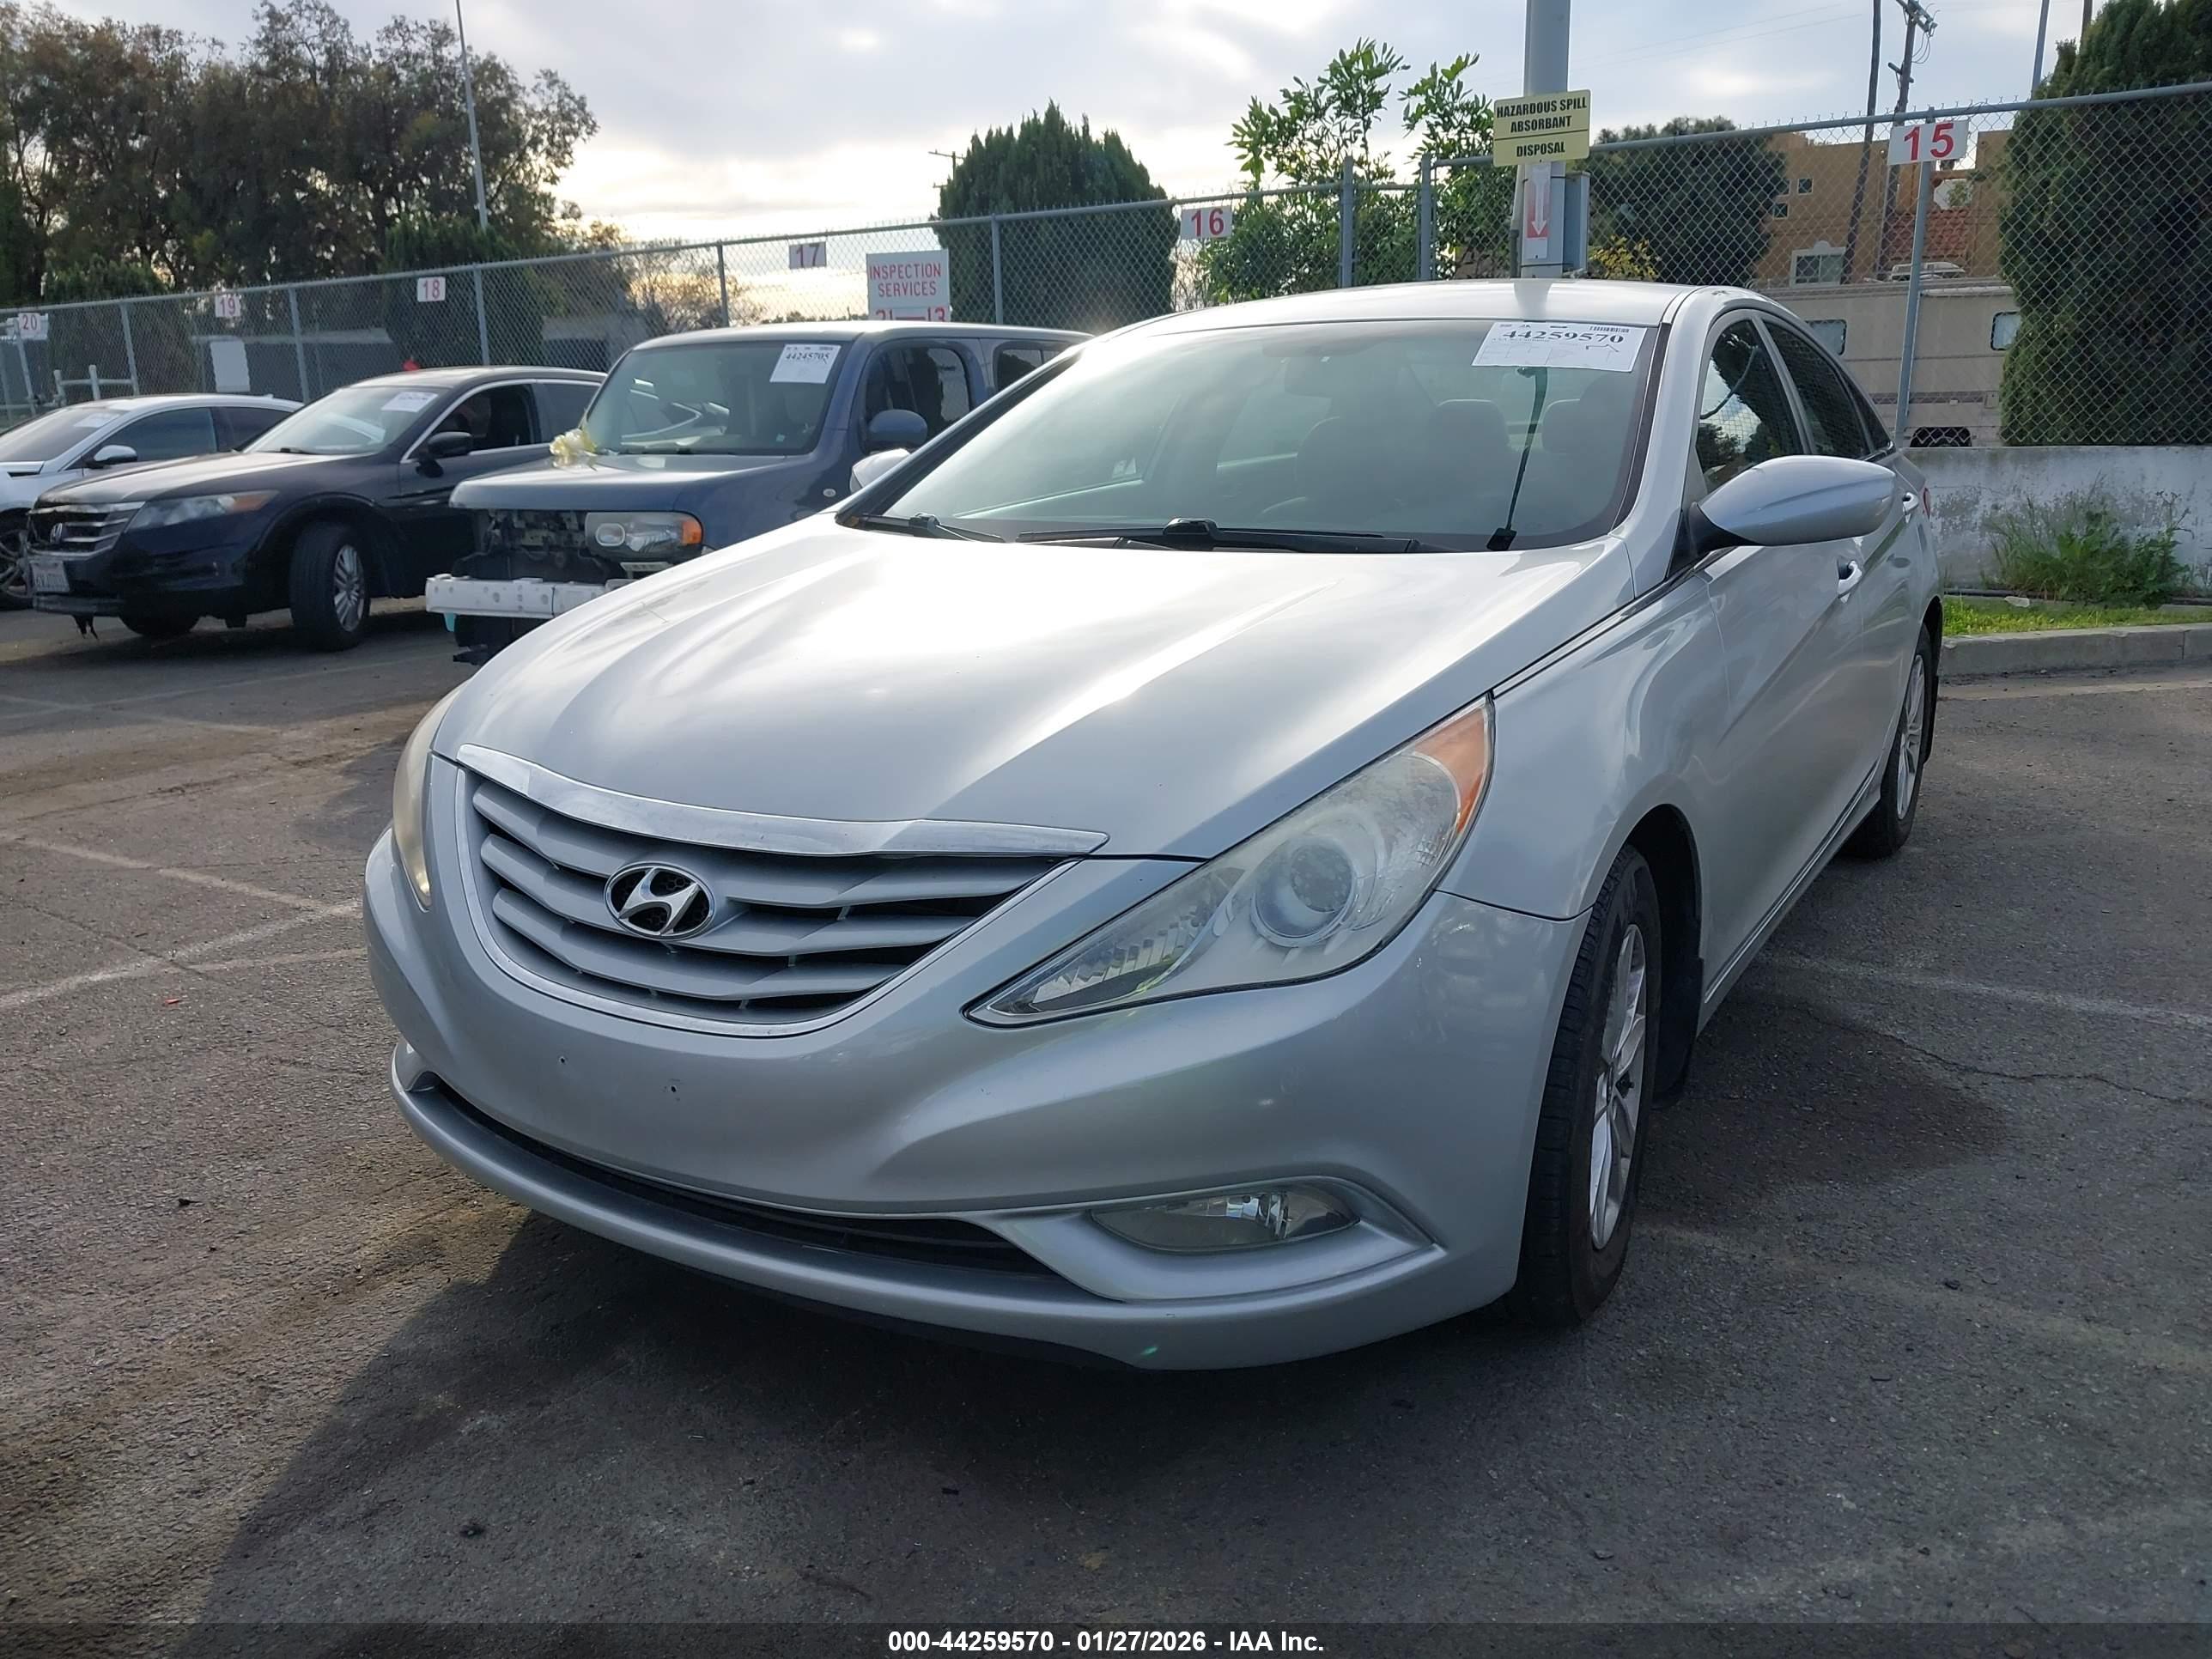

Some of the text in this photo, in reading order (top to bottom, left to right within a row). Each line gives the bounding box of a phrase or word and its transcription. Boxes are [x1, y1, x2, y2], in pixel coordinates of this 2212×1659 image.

[1497, 97, 1587, 118] HAZARDOUS SPILL
[1510, 115, 1572, 133] ABSORBANT
[1516, 142, 1565, 157] DISPOSAL
[1904, 123, 1954, 161] 15
[1191, 208, 1224, 237] 16
[796, 243, 819, 268] 17
[869, 262, 941, 280] INSPECTION
[423, 279, 441, 300] 18
[878, 281, 936, 297] SERVICES
[220, 297, 235, 316] 19
[22, 314, 38, 331] 20
[1503, 330, 1625, 343] 44259570
